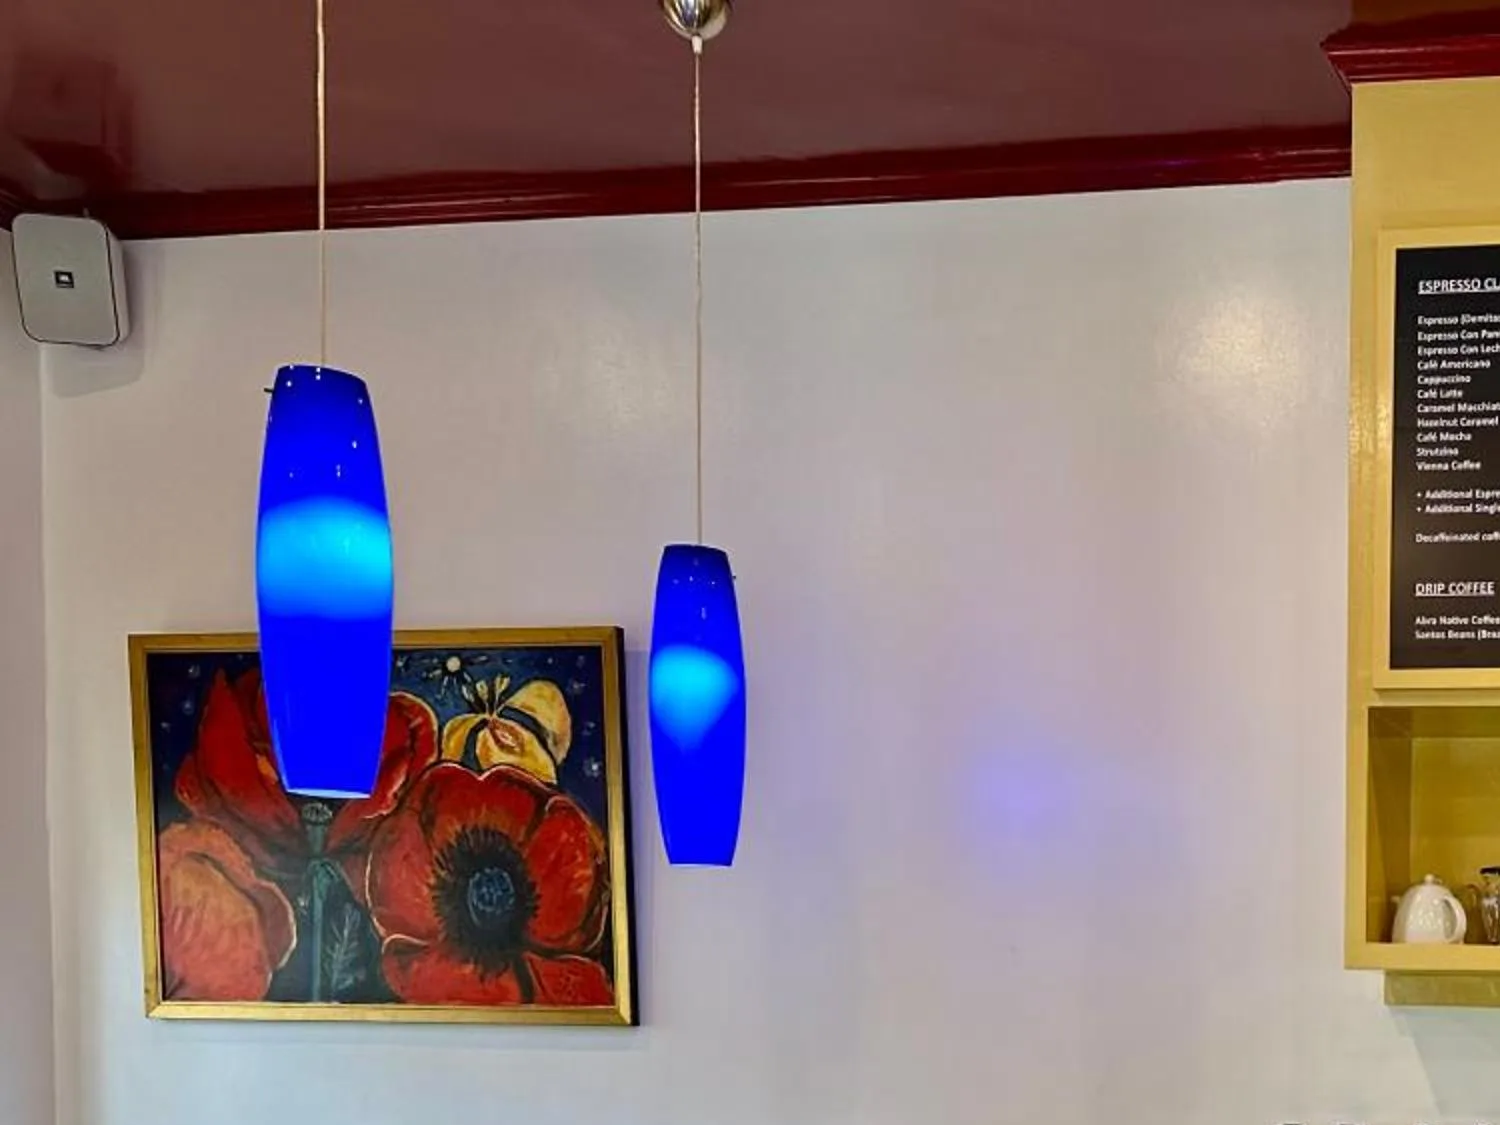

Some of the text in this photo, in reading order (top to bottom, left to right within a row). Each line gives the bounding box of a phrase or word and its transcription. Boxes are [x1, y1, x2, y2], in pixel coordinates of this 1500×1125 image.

[1418, 280, 1481, 294] ESPRESSO
[1418, 315, 1458, 325] Espresso
[1418, 360, 1438, 370] Café
[1440, 360, 1491, 369] Americano
[1417, 404, 1455, 413] Caramel
[1416, 461, 1481, 471] Vienna Coffee
[1425, 490, 1472, 499] Additional
[1416, 582, 1494, 596] DRIP COFFEE
